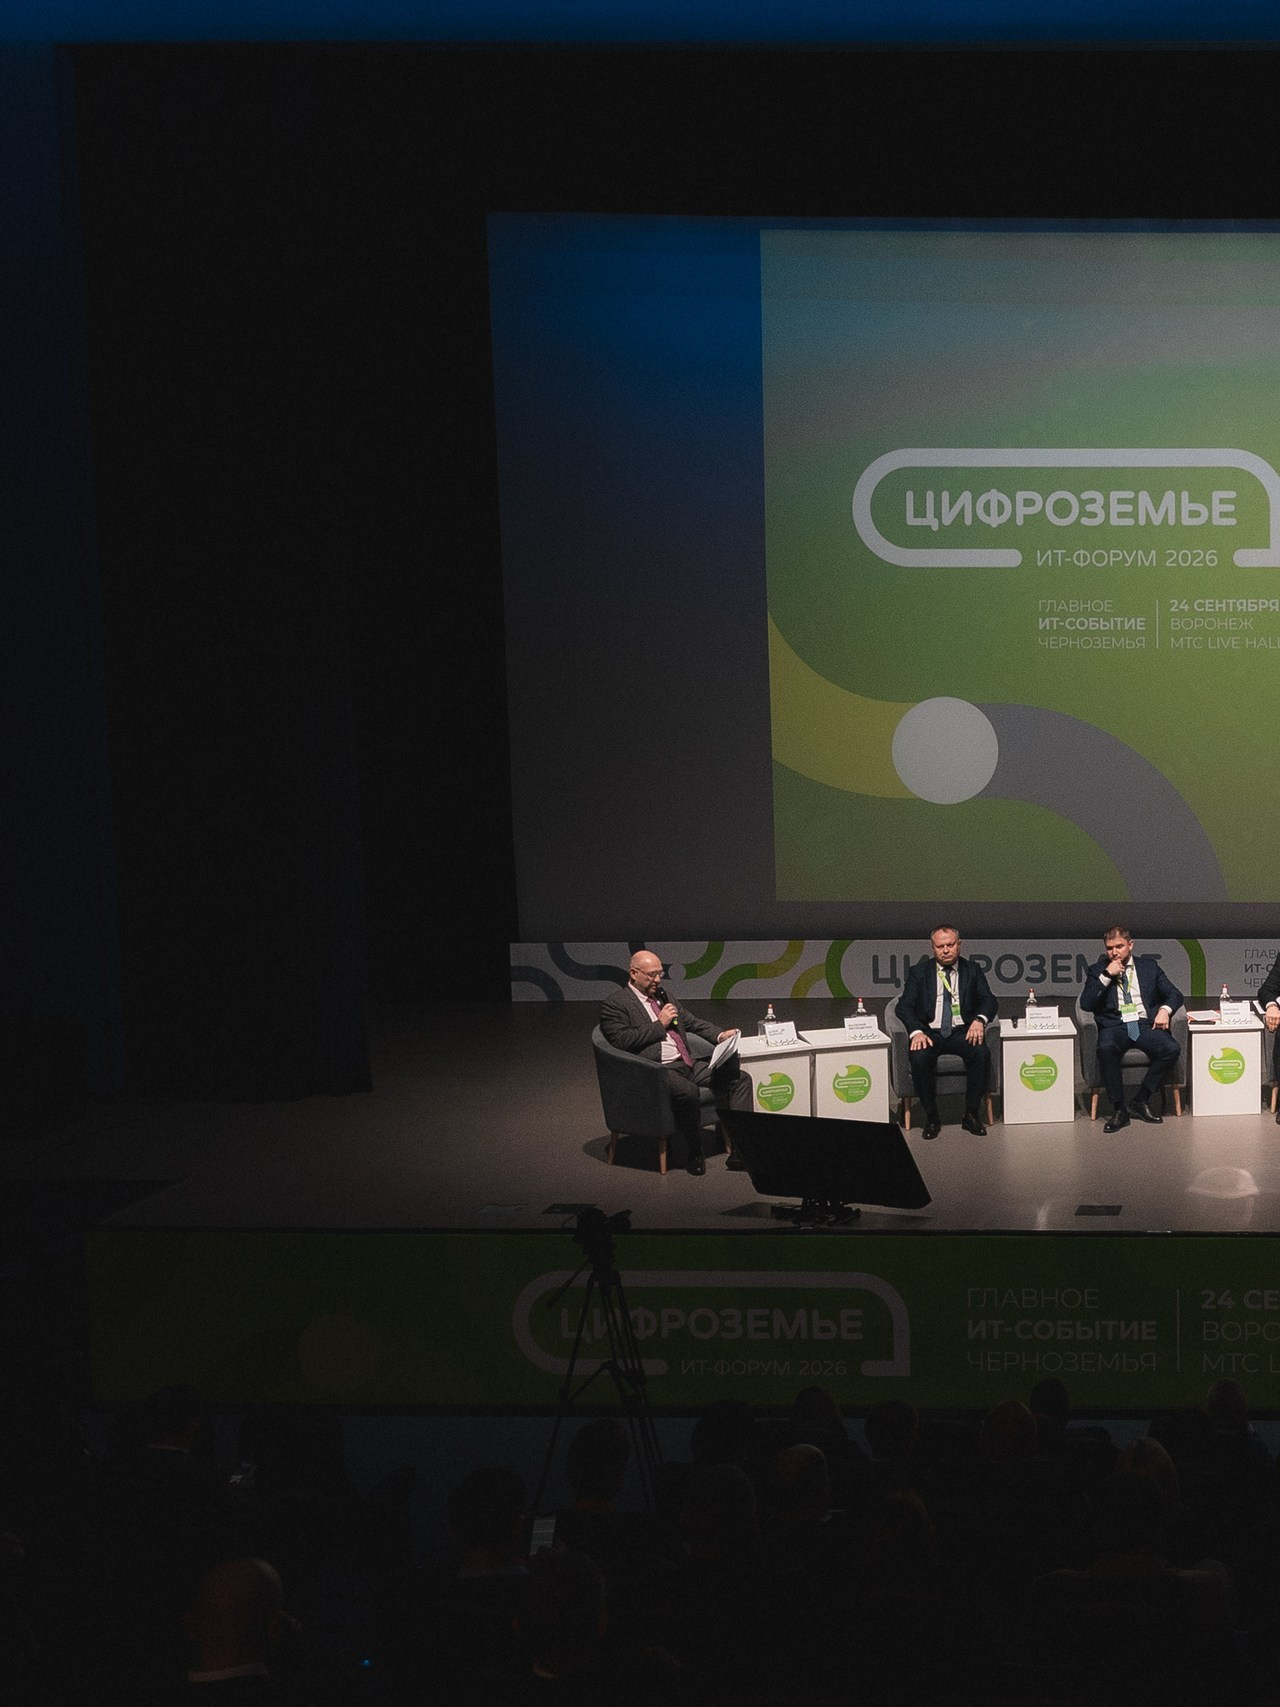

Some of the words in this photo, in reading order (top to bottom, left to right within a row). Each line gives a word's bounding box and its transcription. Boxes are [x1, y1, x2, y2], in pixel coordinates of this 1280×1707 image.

[905, 489, 1237, 531] ЦИФРОЗЕМЬЕ
[1036, 548, 1157, 567] ИТ-ФОРУМ
[1166, 549, 1219, 567] 2026
[1038, 599, 1113, 613] ГЛАВНОЕ
[1169, 599, 1190, 612] 24
[1193, 599, 1280, 613] СЕНТЯБРЯ
[1038, 617, 1146, 631] ИТ-СОБЫТИЕ
[1170, 617, 1254, 631] ВОРОНЕЖ
[1038, 636, 1146, 650] ЧЕРНОЗЕМЬЯ
[1207, 637, 1241, 650] LIVE
[967, 1287, 1099, 1310] ГЛАВНОЕ
[1200, 1289, 1235, 1311] 24
[967, 1319, 1158, 1341] ИТ-СОБЫТИЕ
[680, 1359, 791, 1377] ИТ-ФОРУМ
[799, 1360, 848, 1377] 2026
[967, 1351, 1158, 1373] ЧЕРНОЗЕМЬЯ
